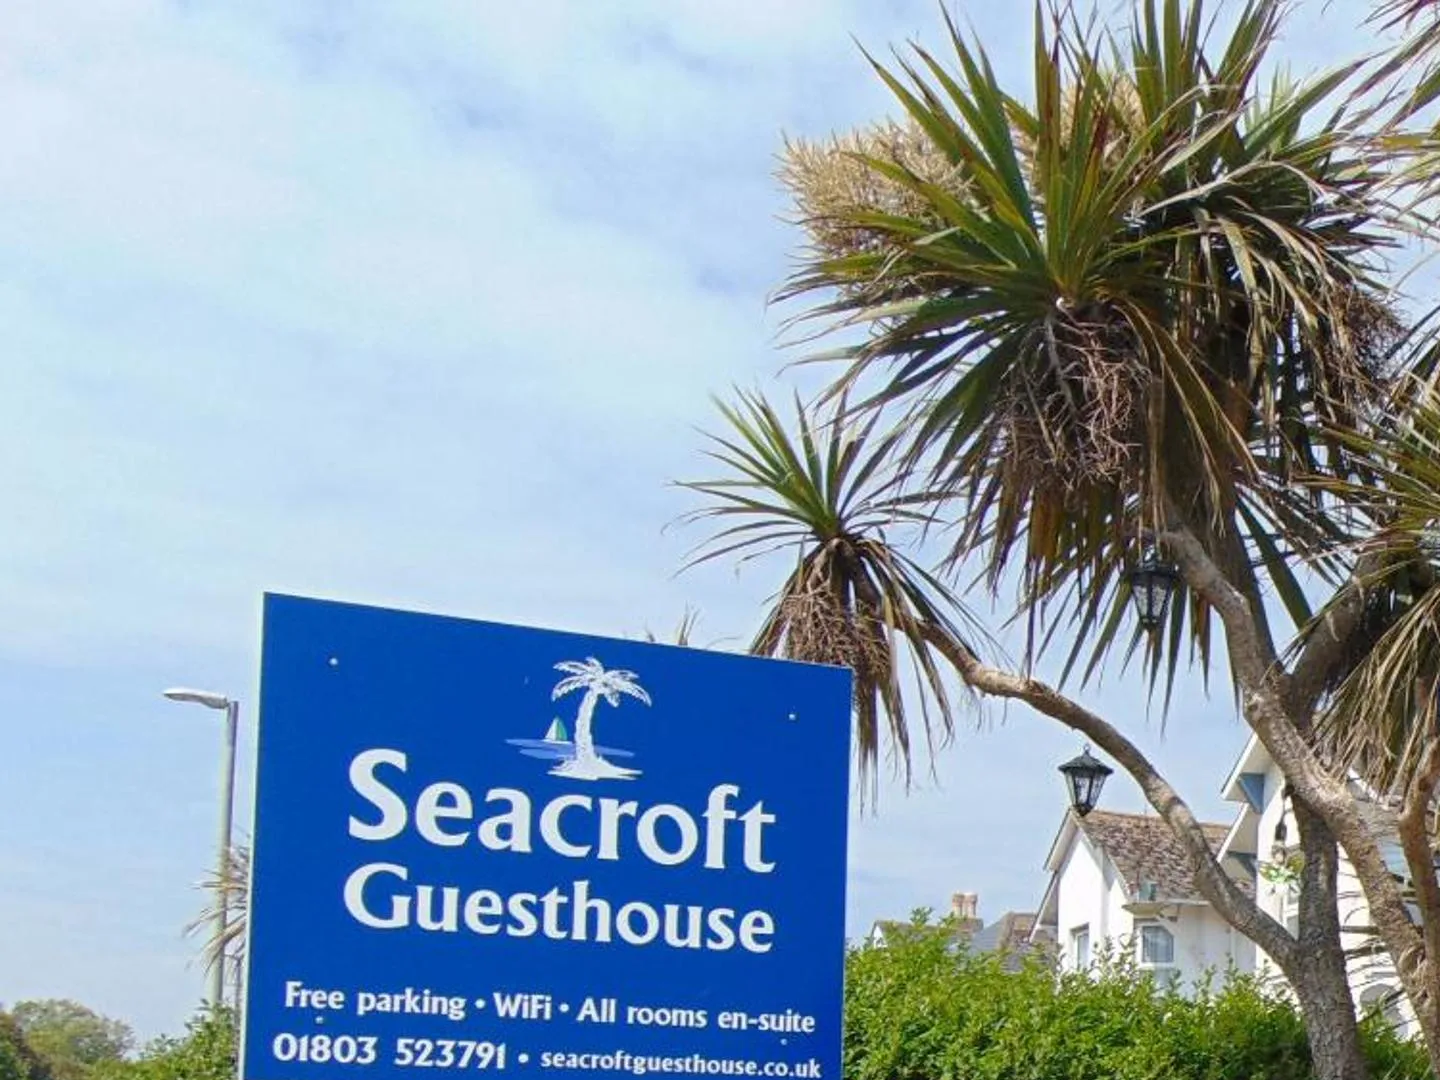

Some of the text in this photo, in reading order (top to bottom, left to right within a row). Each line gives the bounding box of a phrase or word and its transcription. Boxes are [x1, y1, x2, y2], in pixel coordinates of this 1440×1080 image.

[348, 748, 776, 873] Seacroft
[343, 862, 775, 953] Guesthouse
[285, 980, 815, 1033] Free parking WiFi All rooms en-suite
[272, 1032, 821, 1079] 01803 523791 seacroftguesthouse.co.uk
